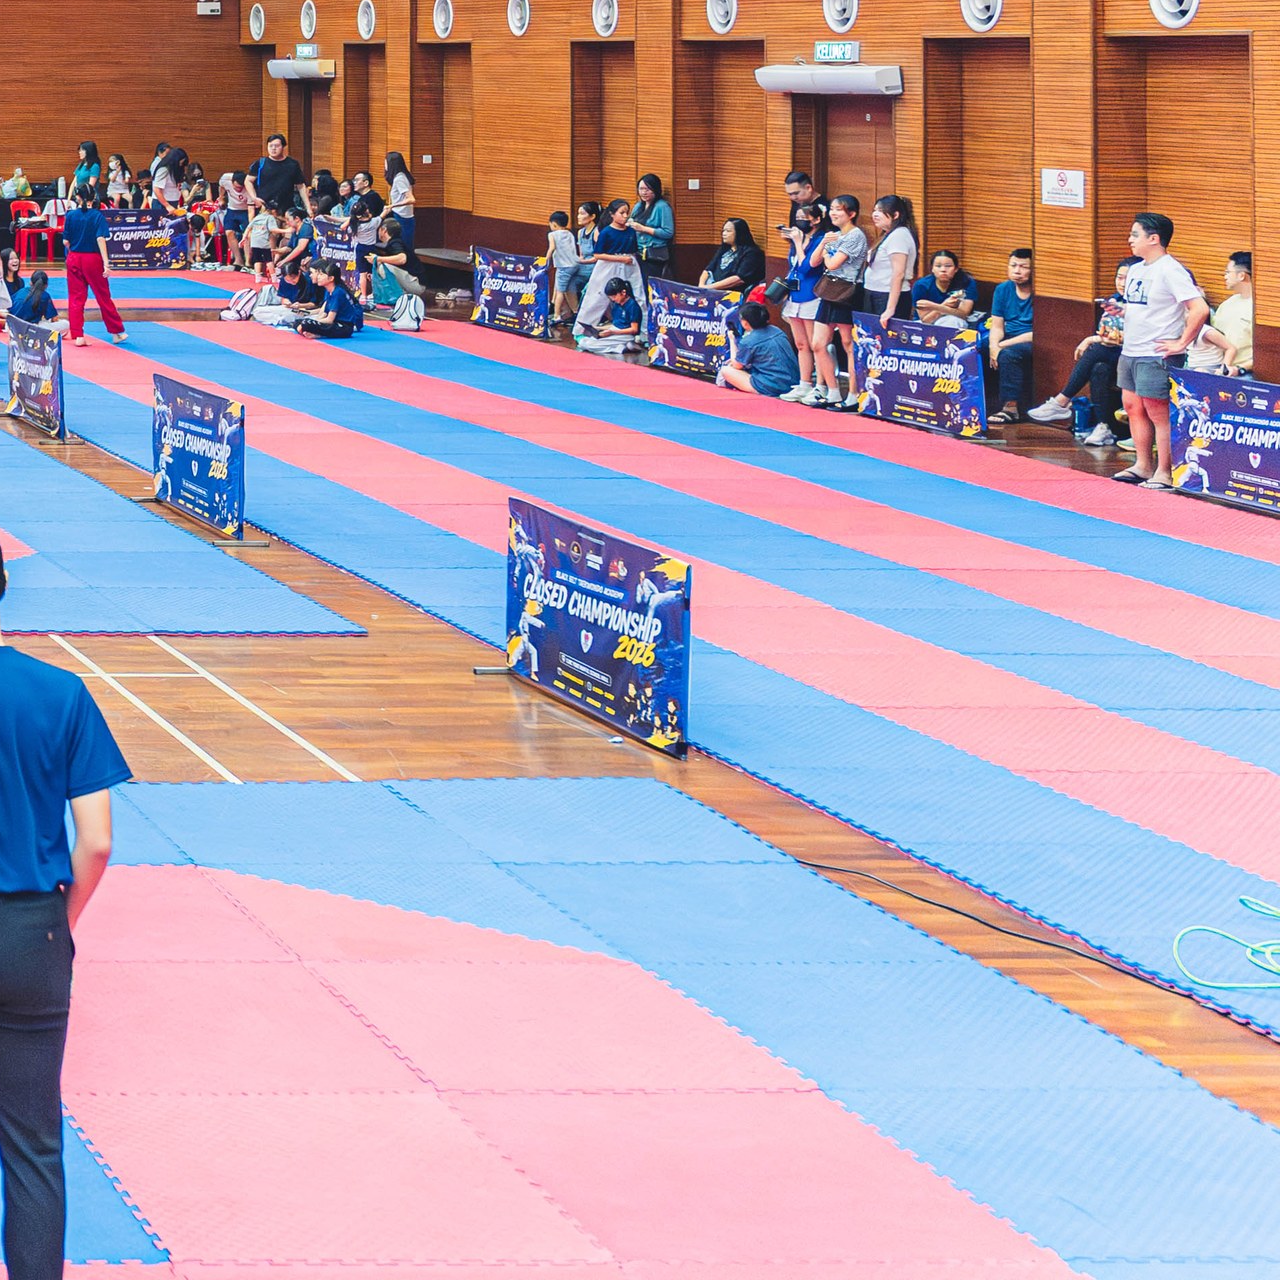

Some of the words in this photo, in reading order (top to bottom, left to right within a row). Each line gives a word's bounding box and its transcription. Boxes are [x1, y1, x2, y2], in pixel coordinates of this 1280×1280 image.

[113, 229, 175, 241] CHAMPIONSHIP
[867, 354, 899, 372] CLOSED
[900, 359, 964, 382] CHAMPIONSHIP
[932, 377, 961, 394] 2026
[161, 425, 184, 449] CLOSED
[185, 433, 231, 464] CHAMPIONSHIP
[1189, 419, 1234, 441] CLOSED
[1235, 426, 1280, 450] CHAMPI
[208, 460, 228, 480] 2026
[523, 572, 568, 610] CLOSED
[568, 591, 662, 643] CHAMPIONSHIP
[613, 635, 656, 667] 2026
